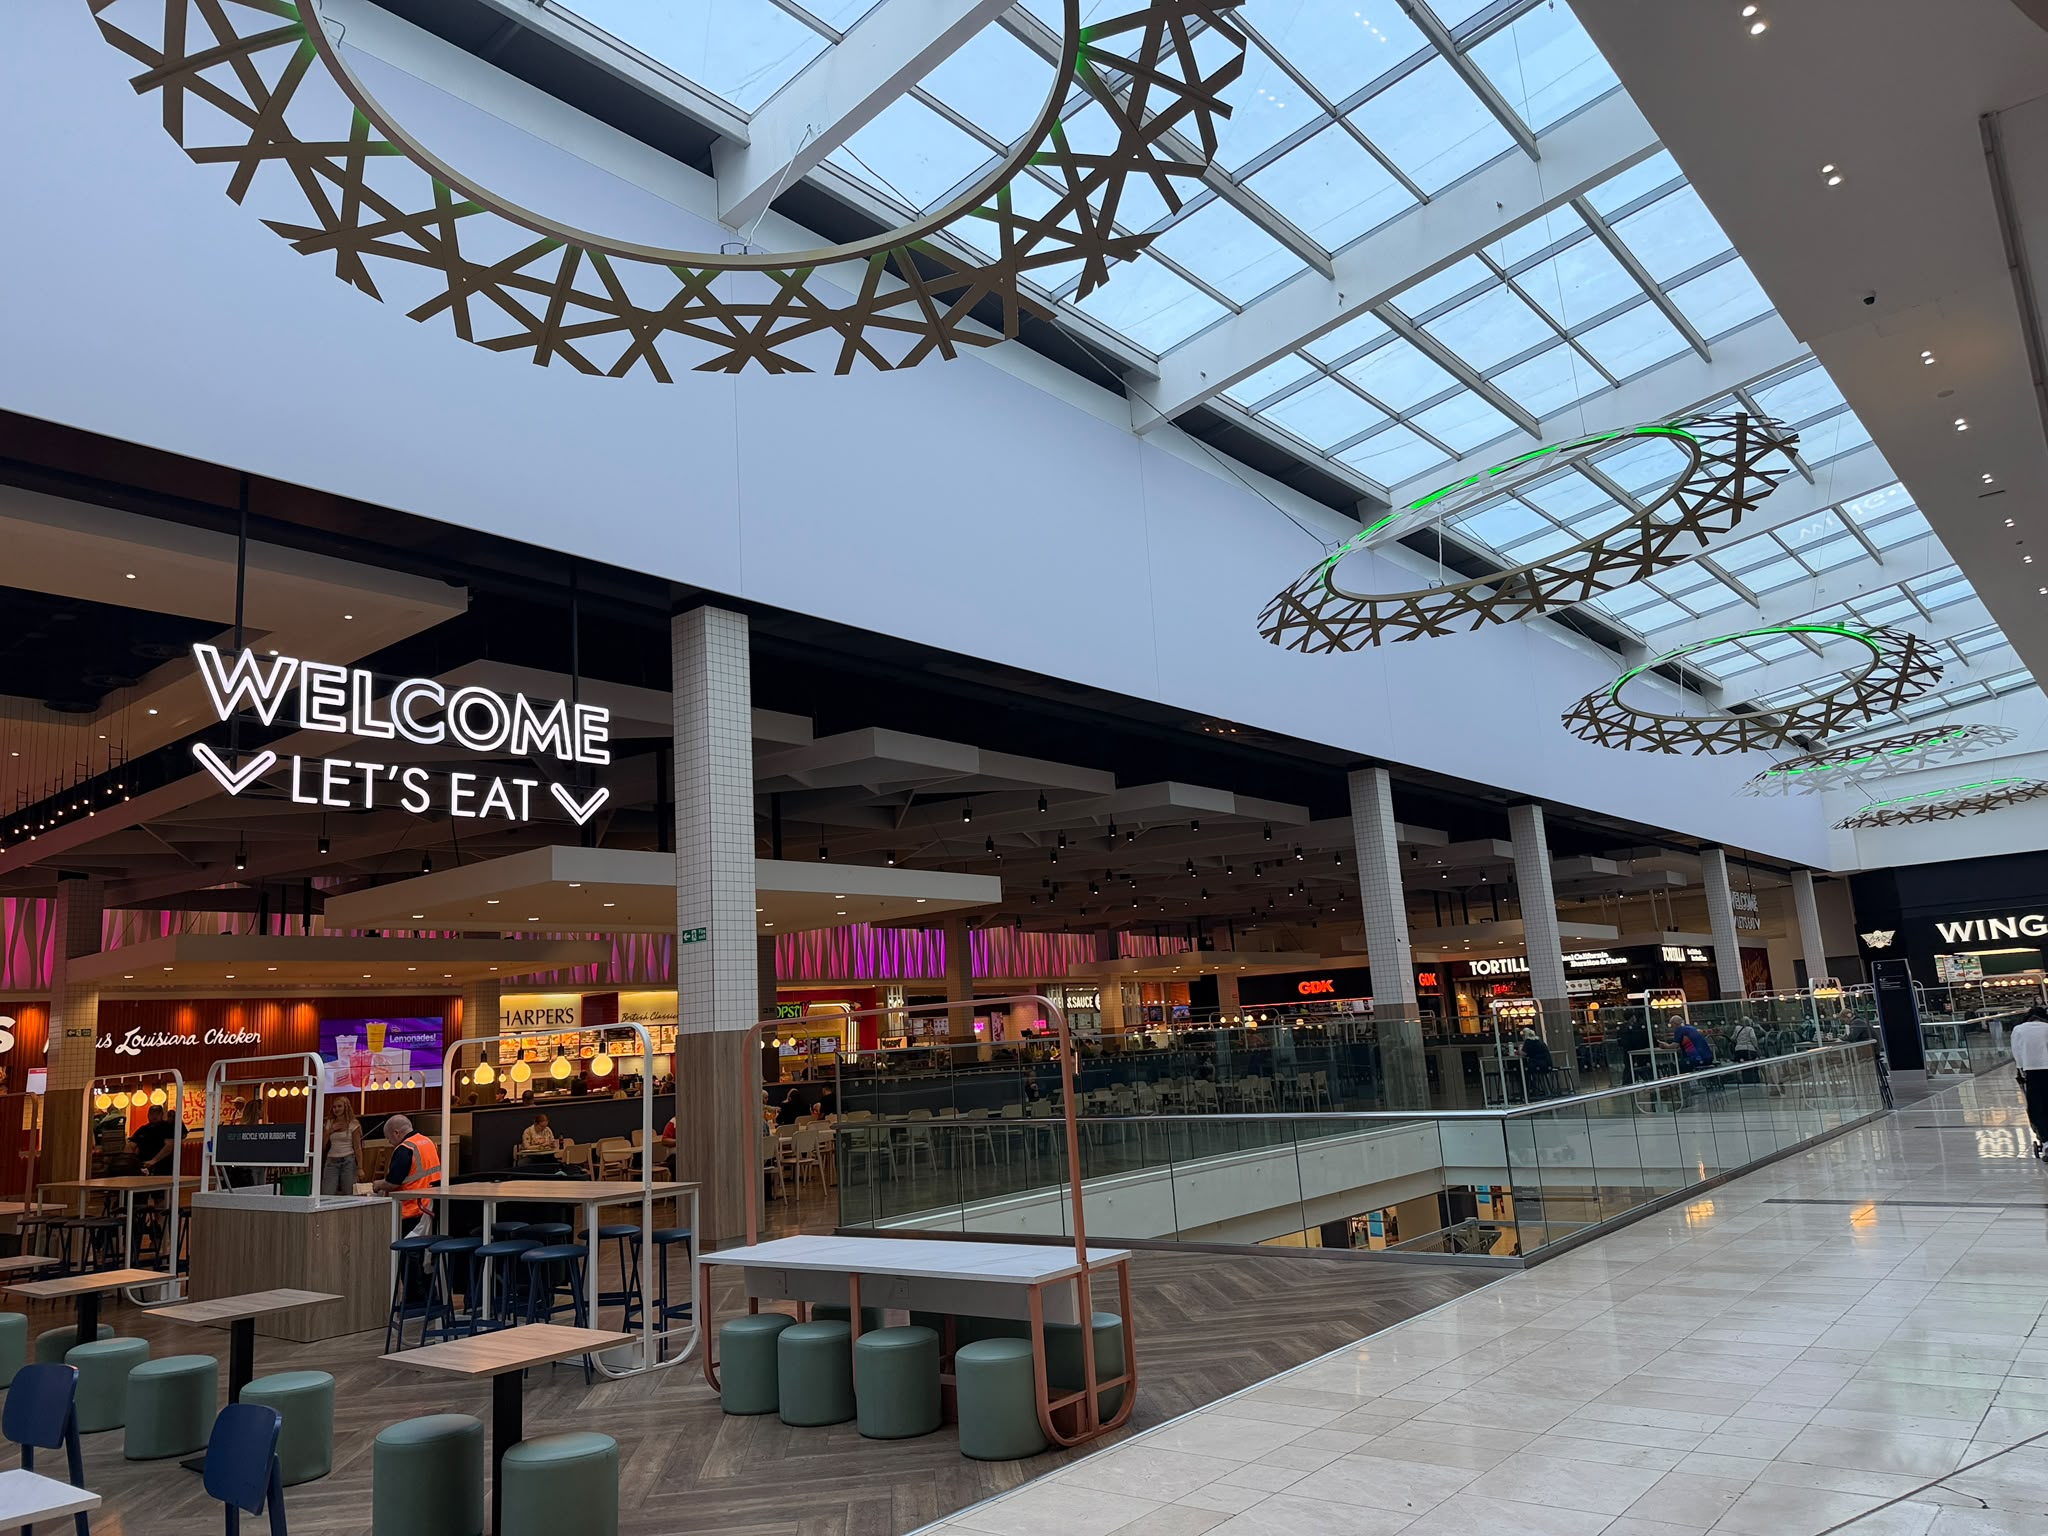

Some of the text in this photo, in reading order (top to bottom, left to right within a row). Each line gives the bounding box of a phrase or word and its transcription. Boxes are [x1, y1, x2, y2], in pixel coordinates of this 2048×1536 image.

[193, 643, 610, 765] WELCOME
[293, 755, 538, 821] LET'S EAT
[1935, 915, 2048, 944] WING
[1298, 980, 1335, 995] GDK
[1418, 973, 1438, 986] GDK
[500, 1007, 575, 1027] HARPER'S
[621, 1011, 649, 1023] British
[115, 1026, 200, 1056] Louisiana
[204, 1027, 262, 1046] Chicken
[389, 1033, 437, 1043] Lemonades!
[258, 1132, 269, 1140] YOUR
[286, 1131, 296, 1140] HERE
